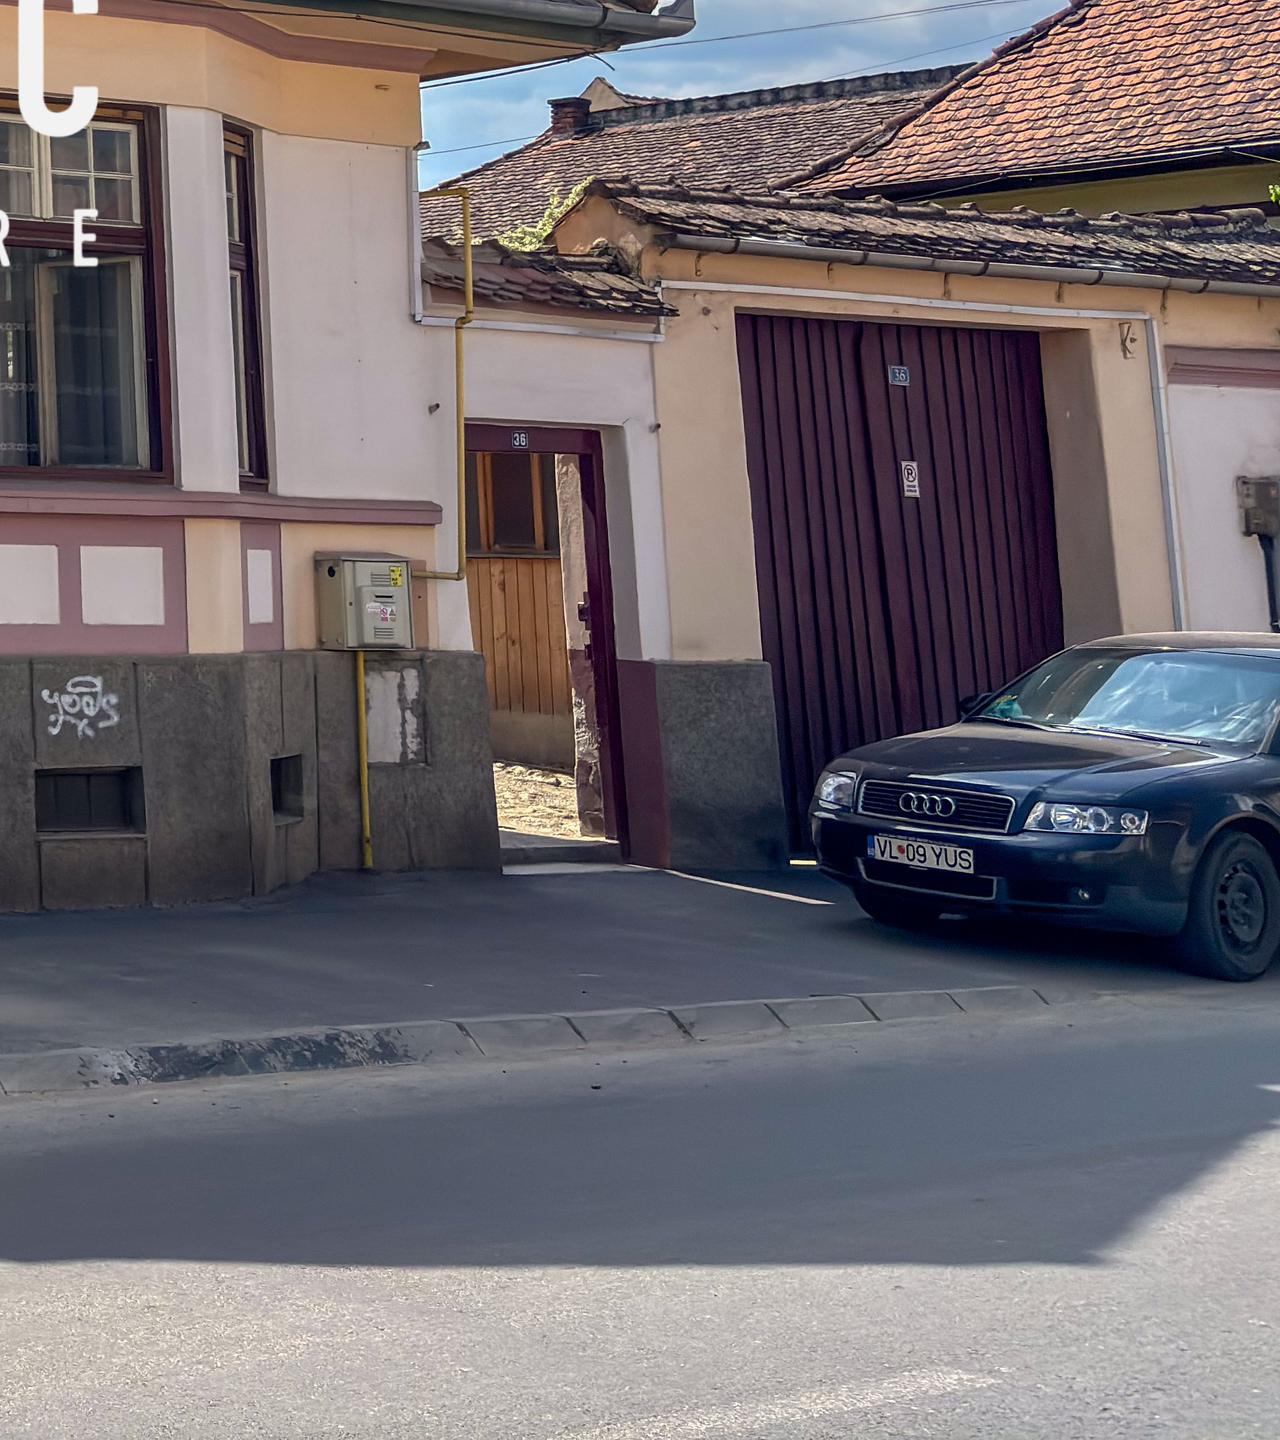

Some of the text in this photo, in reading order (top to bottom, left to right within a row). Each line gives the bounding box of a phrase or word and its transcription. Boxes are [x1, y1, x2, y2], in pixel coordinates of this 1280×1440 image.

[513, 432, 526, 446] 36
[877, 837, 972, 870] VL 09 YUS
